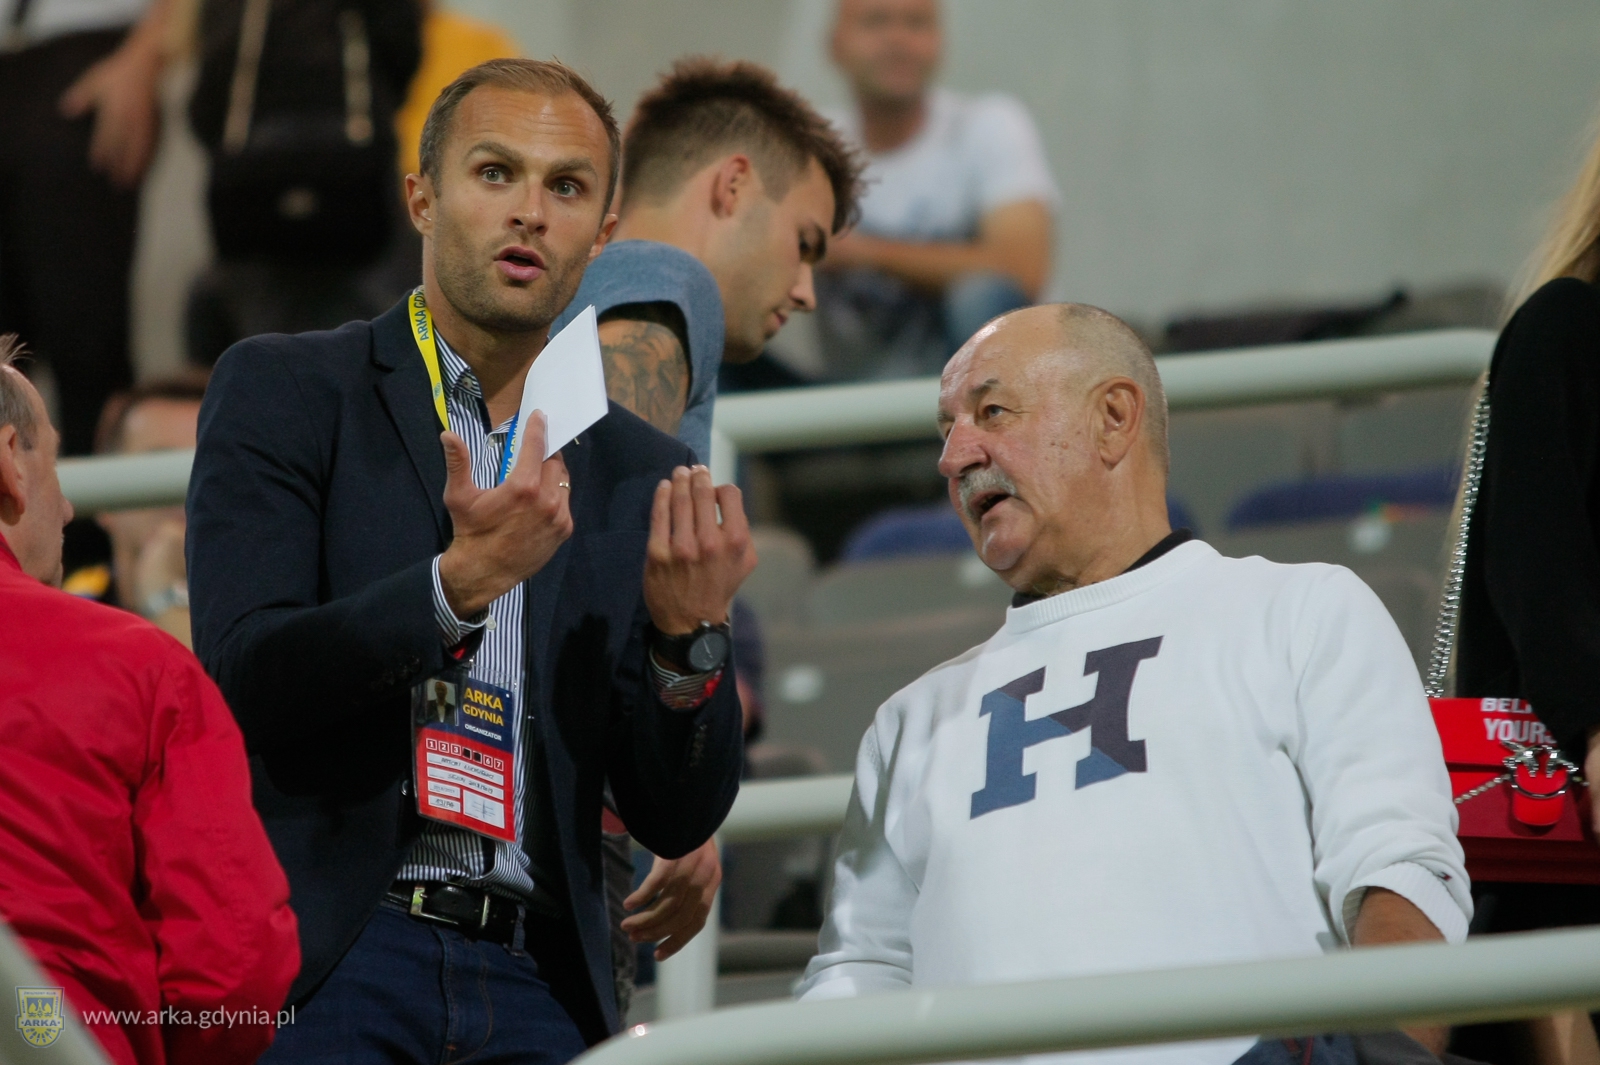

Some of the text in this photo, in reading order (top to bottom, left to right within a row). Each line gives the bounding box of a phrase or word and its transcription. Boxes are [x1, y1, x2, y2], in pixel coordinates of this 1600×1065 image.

[414, 309, 429, 341] ARKA
[464, 687, 503, 712] ARKA
[1480, 697, 1533, 714] BEL
[462, 704, 504, 727] GDYNIA
[969, 634, 1165, 820] H
[464, 723, 502, 742] ORGANIZATOR
